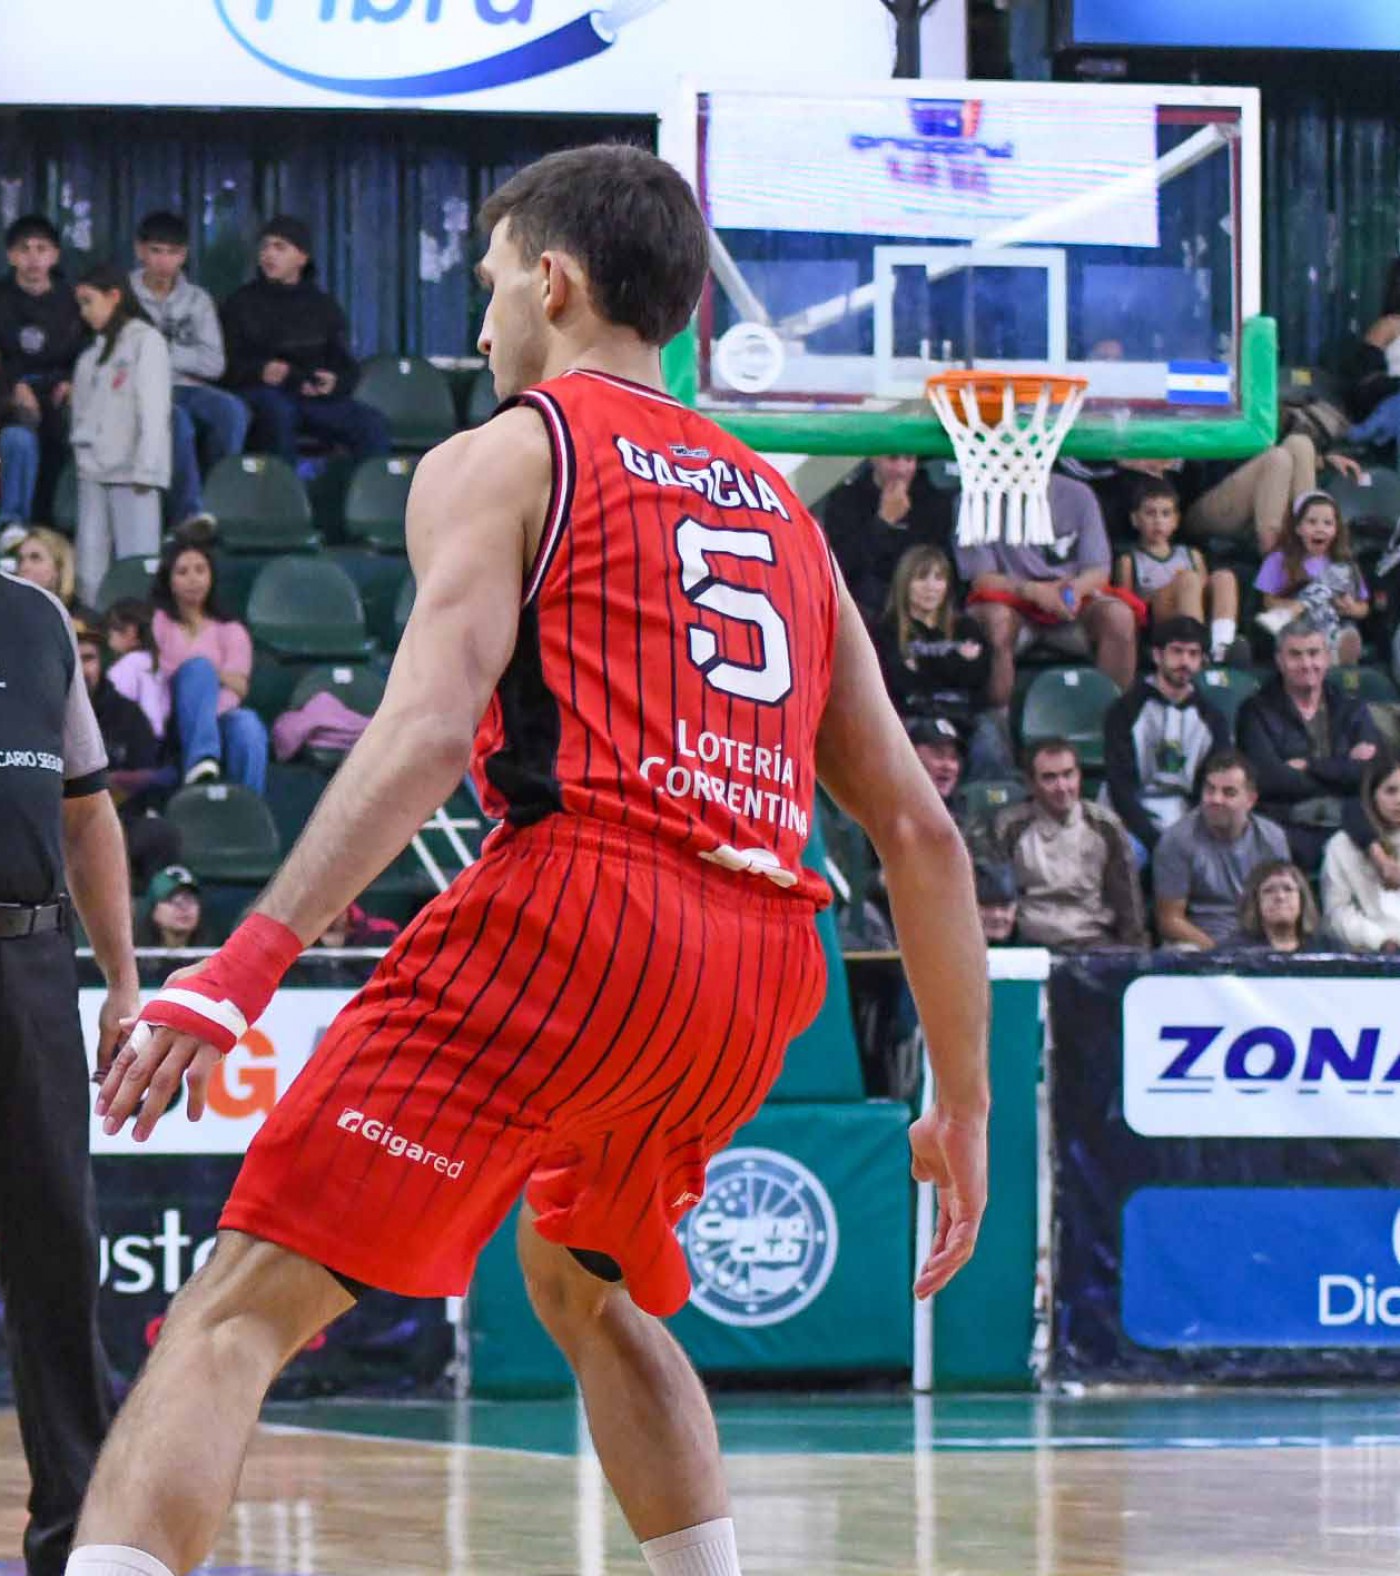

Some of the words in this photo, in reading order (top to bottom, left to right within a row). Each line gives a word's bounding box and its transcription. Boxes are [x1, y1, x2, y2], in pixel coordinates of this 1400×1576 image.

[614, 435, 792, 522] GARCIA
[675, 516, 793, 705] 5
[677, 718, 794, 790] LOTERÍA
[639, 756, 808, 840] CORRENTINA
[1158, 1025, 1400, 1082] ZON
[360, 1118, 465, 1180] Gigared
